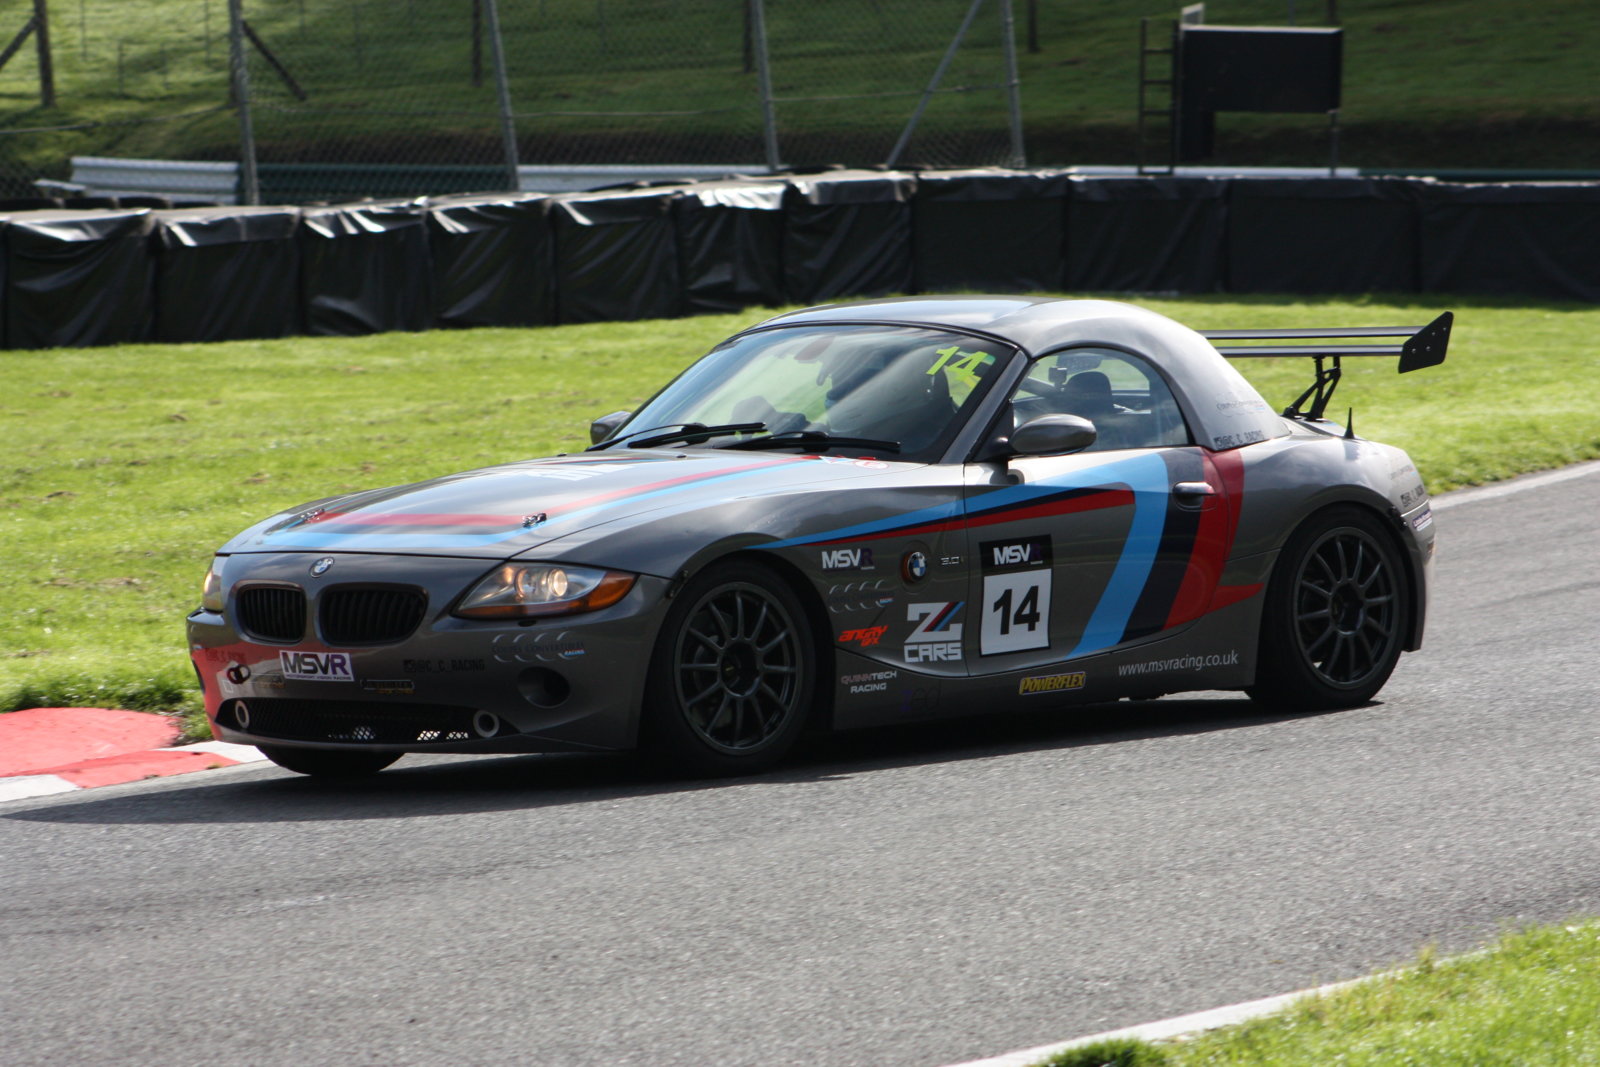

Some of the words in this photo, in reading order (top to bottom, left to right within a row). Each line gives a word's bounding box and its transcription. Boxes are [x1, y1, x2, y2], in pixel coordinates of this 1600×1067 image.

[926, 346, 988, 381] 14
[904, 601, 965, 643] Z
[993, 585, 1040, 635] 14
[281, 652, 349, 675] MSVR
[904, 642, 962, 663] CARS
[1118, 649, 1239, 676] www.msvracing.co.uk
[850, 682, 887, 694] RACING
[1019, 672, 1086, 695] POWERFLEX
